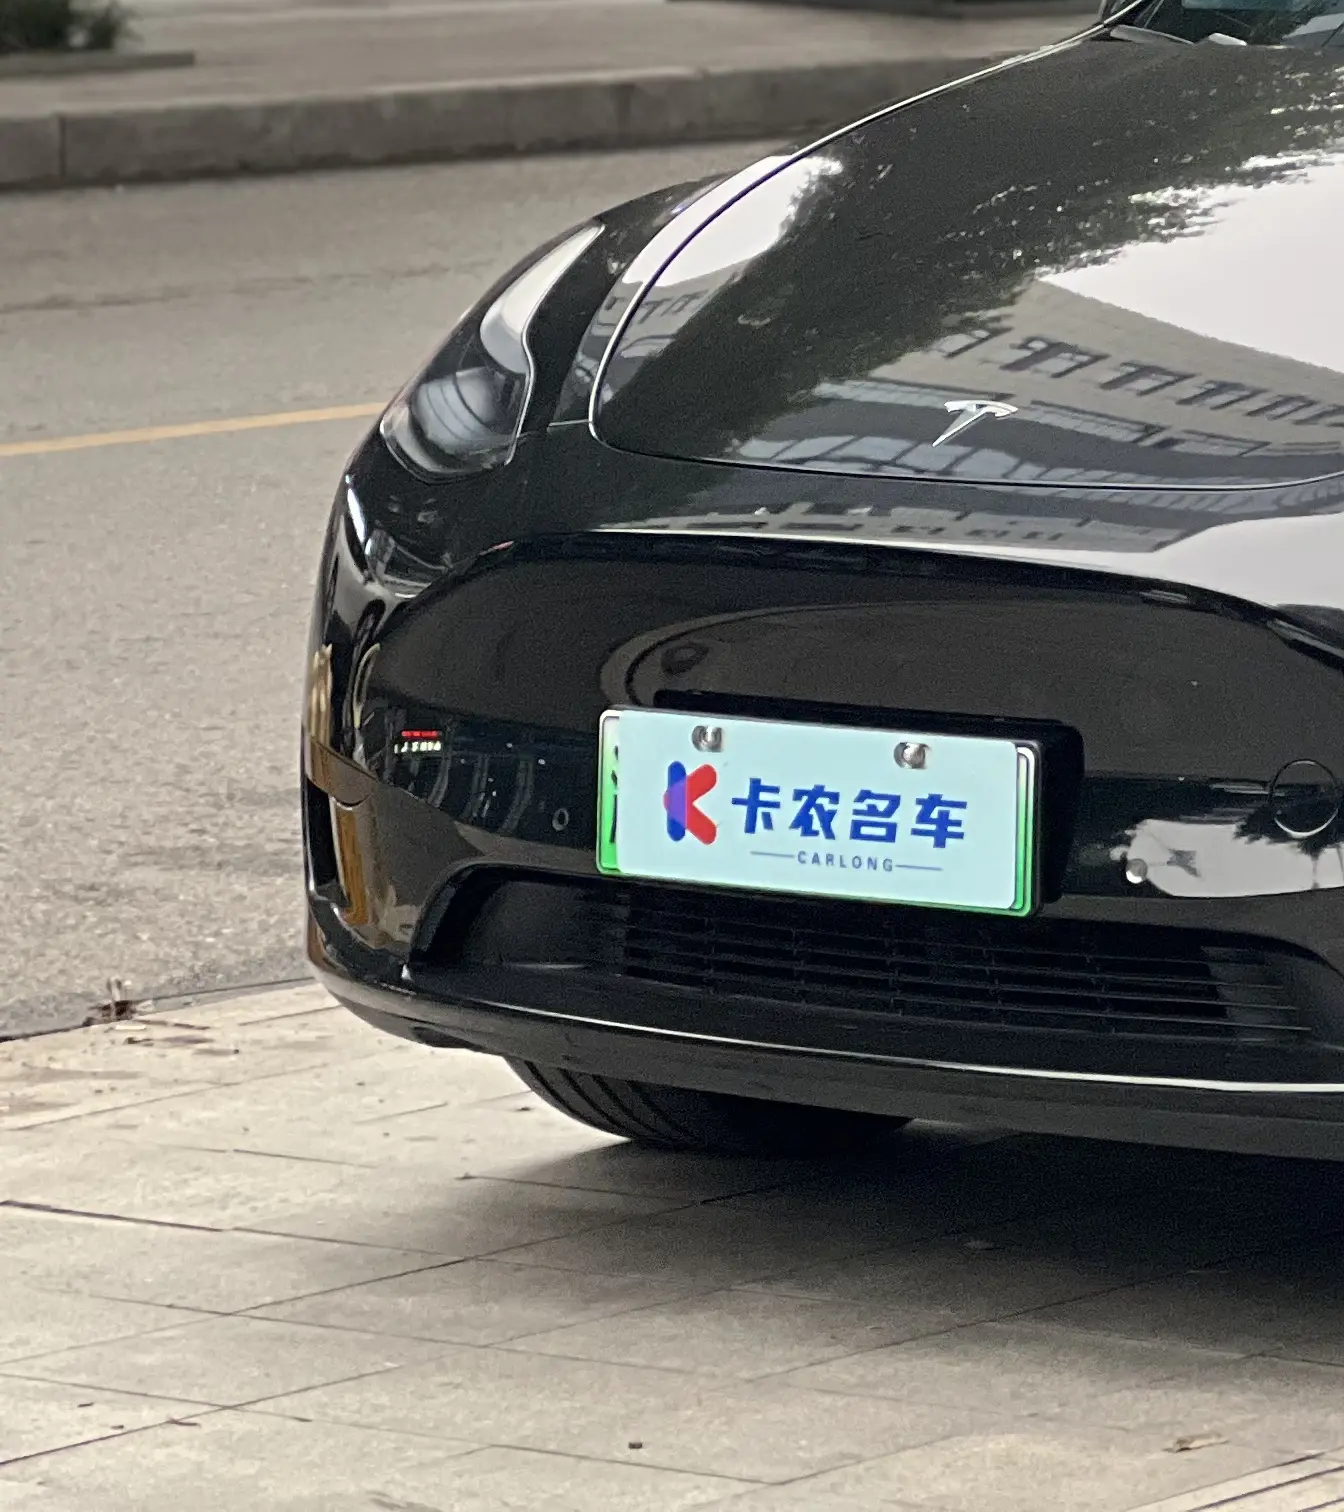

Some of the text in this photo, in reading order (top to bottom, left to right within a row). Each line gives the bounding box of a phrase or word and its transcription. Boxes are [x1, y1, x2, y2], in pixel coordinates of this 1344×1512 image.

[731, 777, 968, 849] 卡农名车
[797, 850, 893, 872] CARLONG
